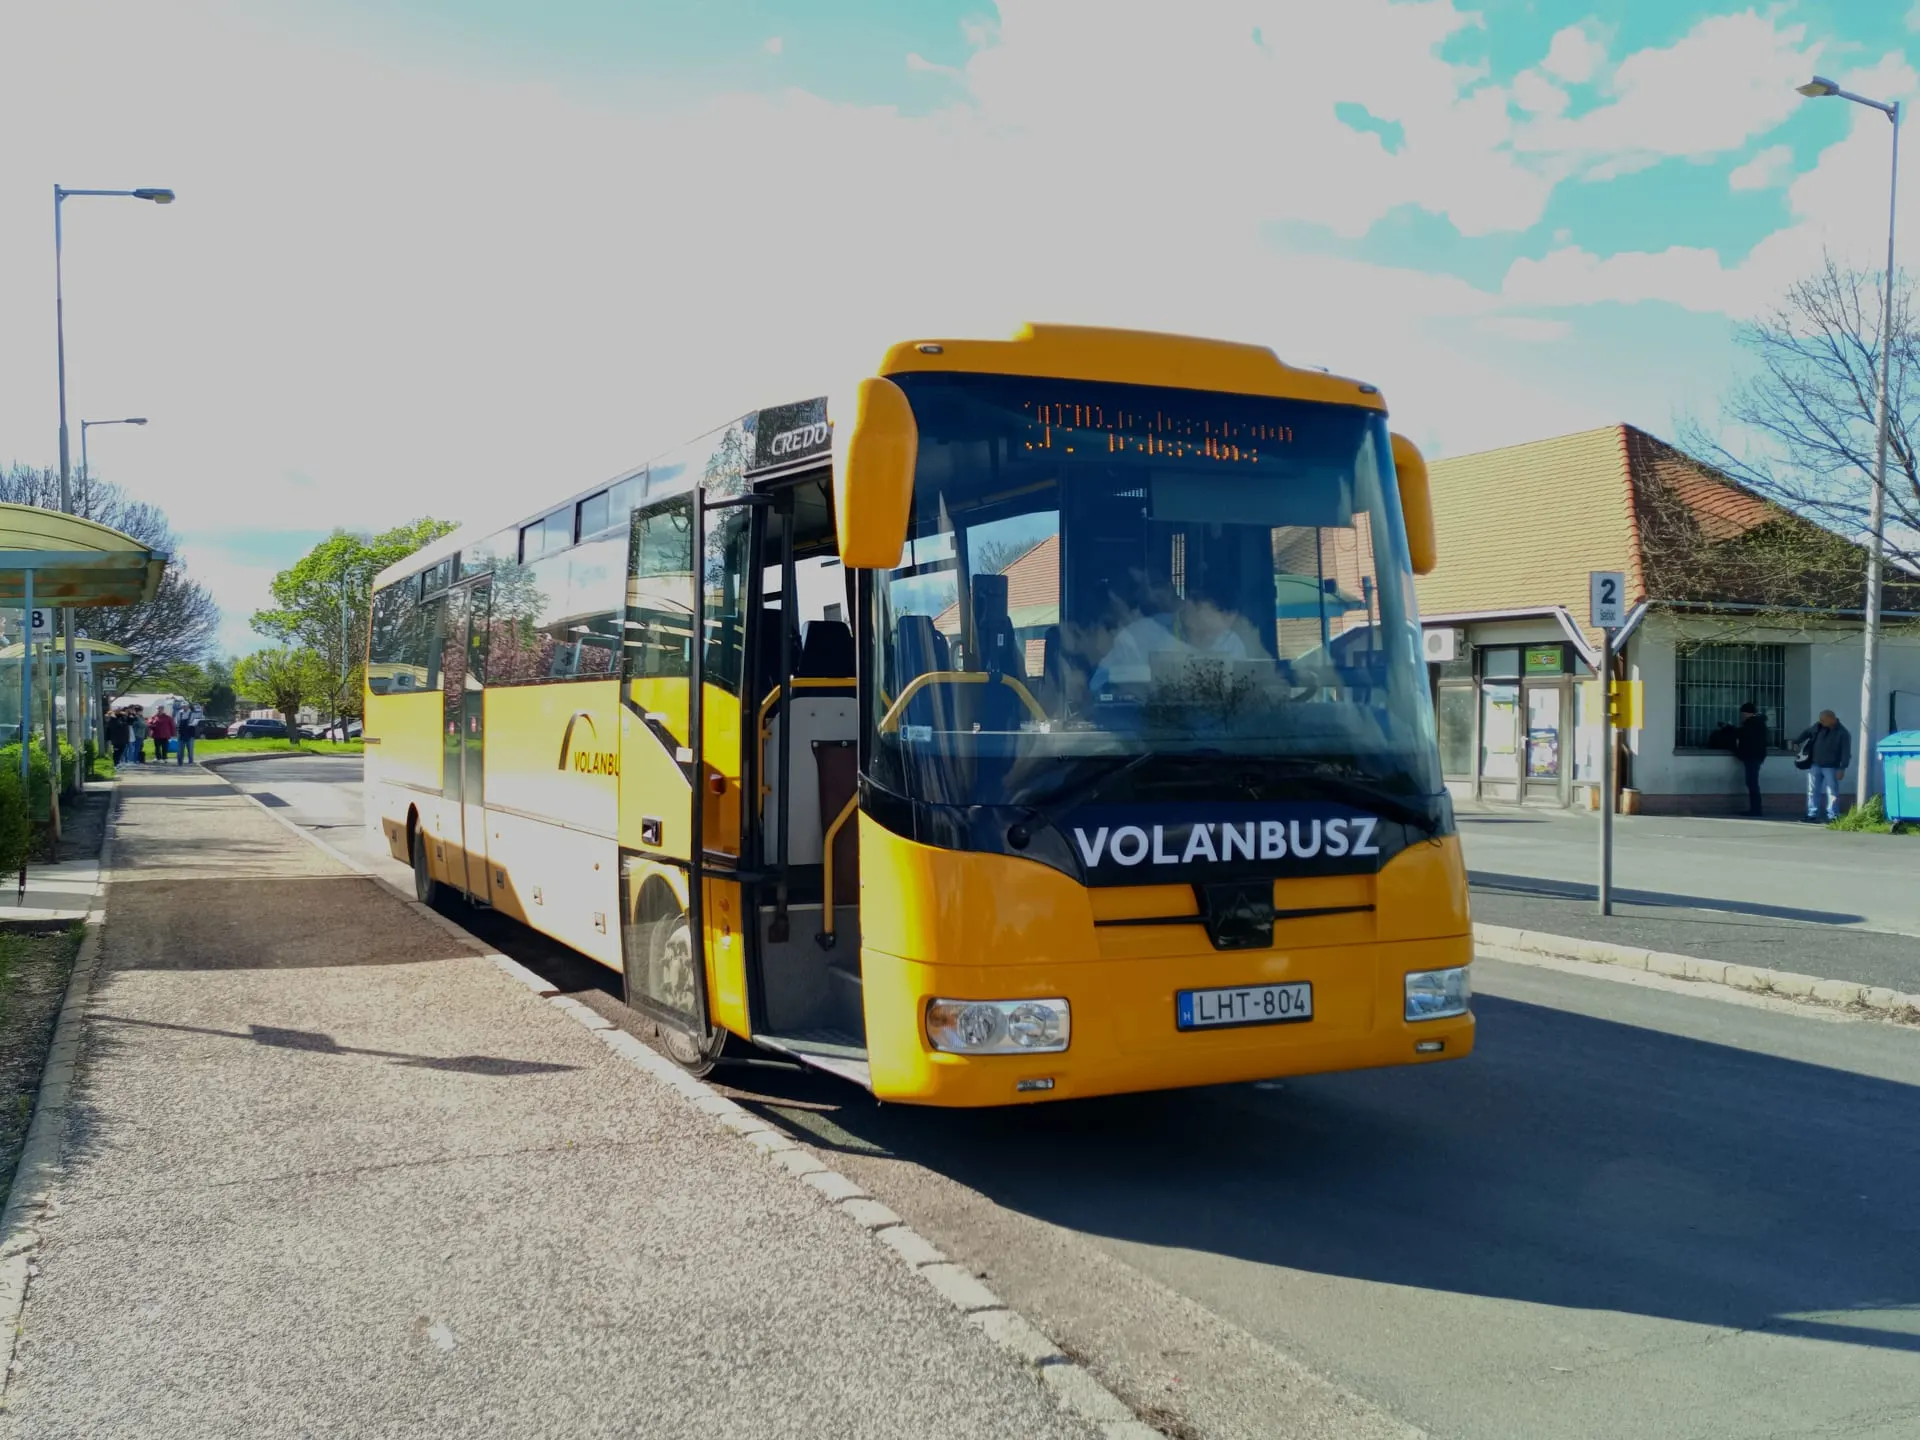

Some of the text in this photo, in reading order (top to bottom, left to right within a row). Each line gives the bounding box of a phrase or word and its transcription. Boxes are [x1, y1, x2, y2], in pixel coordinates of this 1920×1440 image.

[771, 422, 827, 456] CREDO
[1601, 579, 1616, 604] 2
[75, 651, 85, 663] 9
[1073, 817, 1380, 867] VOLÁNBUSZ
[1199, 988, 1305, 1021] LHT-804
